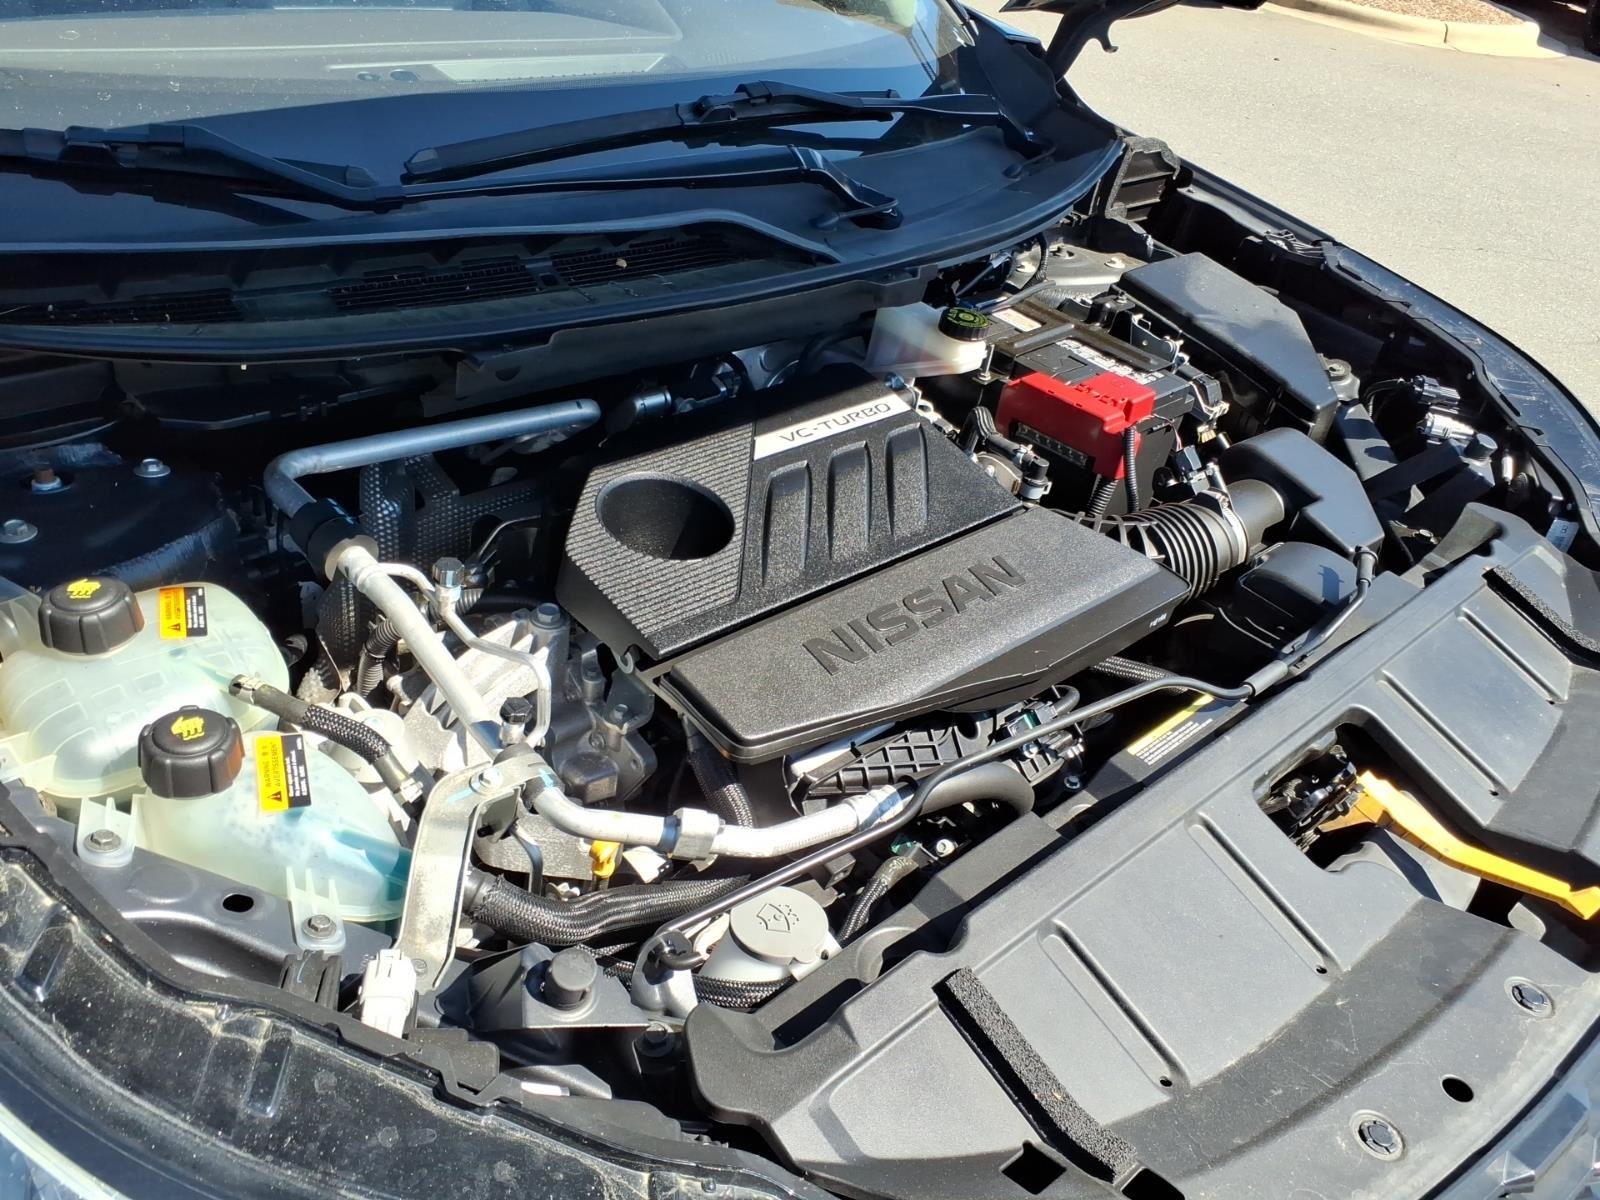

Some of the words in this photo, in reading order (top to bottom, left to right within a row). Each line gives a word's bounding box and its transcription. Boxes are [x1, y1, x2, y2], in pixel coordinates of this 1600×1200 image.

[779, 402, 892, 442] VC-TURBO
[802, 555, 1026, 676] NISSAN
[262, 761, 272, 788] WARNING
